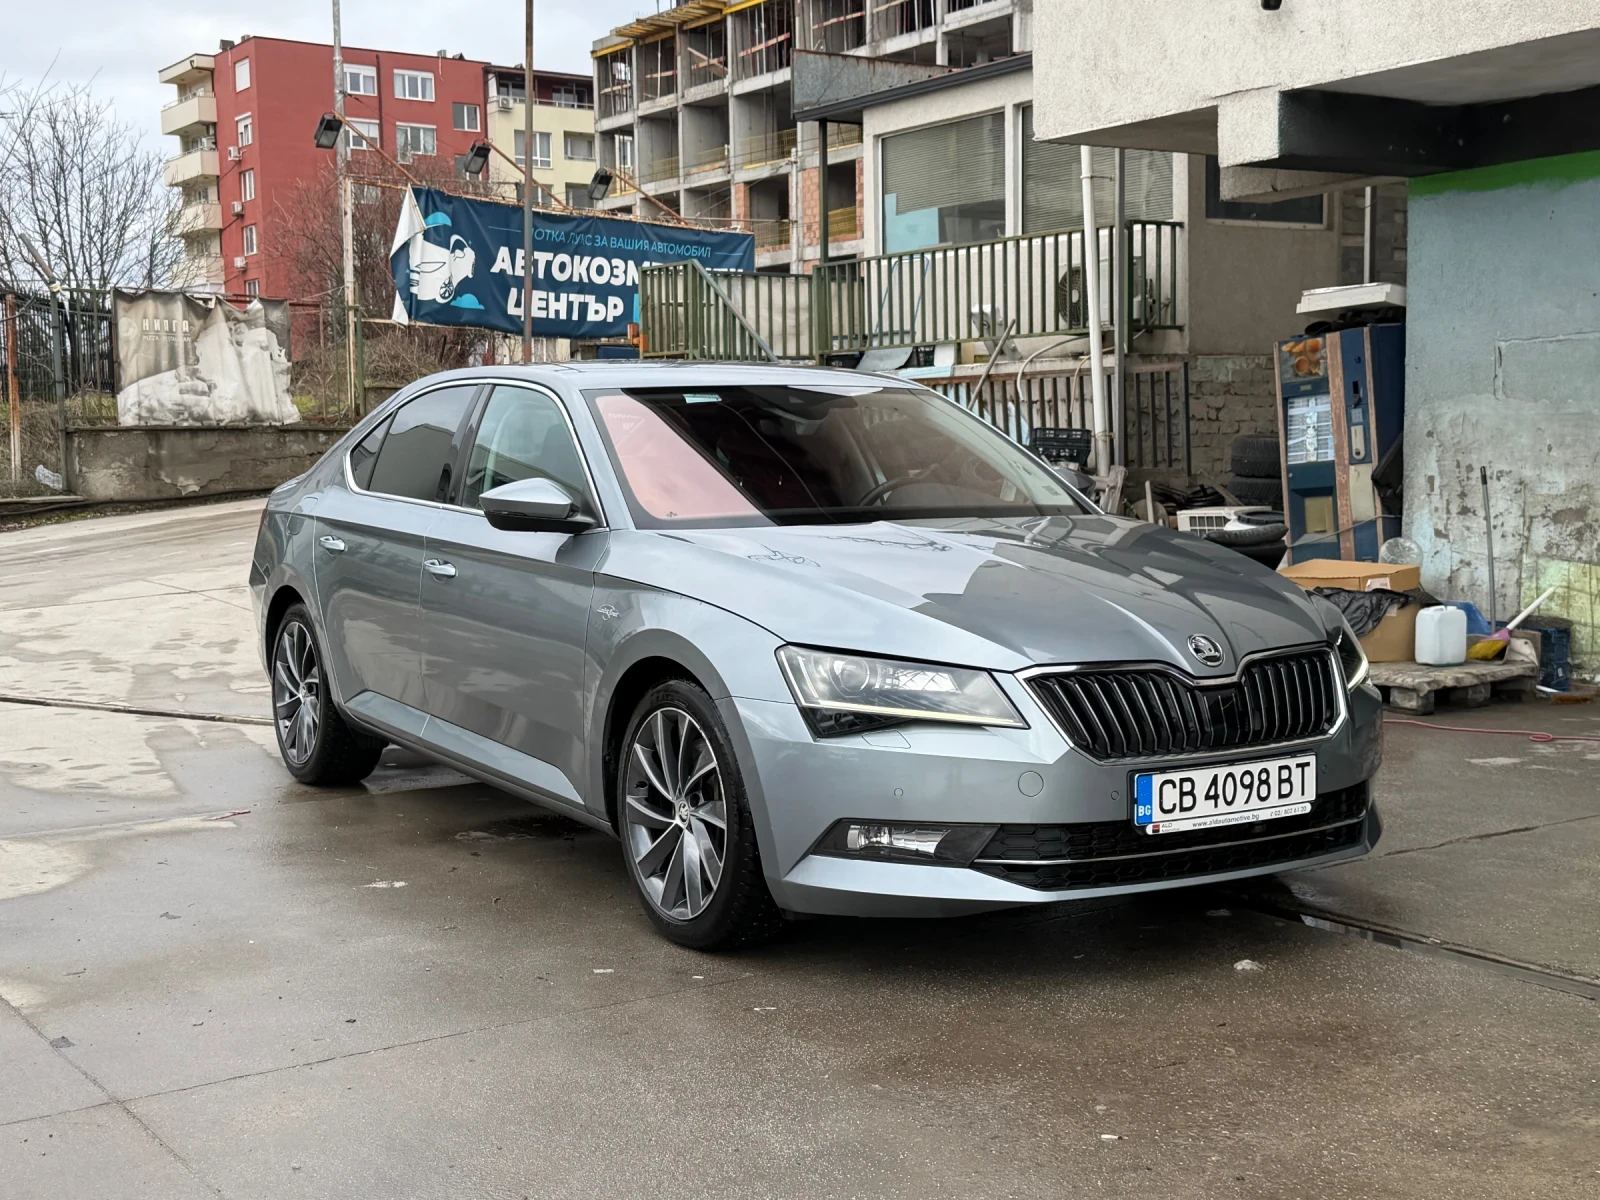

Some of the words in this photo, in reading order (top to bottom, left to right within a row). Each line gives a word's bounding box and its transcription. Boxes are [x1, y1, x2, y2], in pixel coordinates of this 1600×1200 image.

[532, 228, 566, 243] ОТКА
[594, 235, 608, 247] ЗА
[610, 237, 650, 251] ВАШИЯ
[651, 242, 712, 258] АВТОМОБИЛ
[507, 287, 624, 323] ЦЕНТЪР
[1158, 776, 1197, 815] CB
[1204, 767, 1272, 809] 4098
[1277, 761, 1311, 800] BT
[1138, 805, 1152, 817] BG
[1192, 813, 1260, 827] www.aldautomotive.bg
